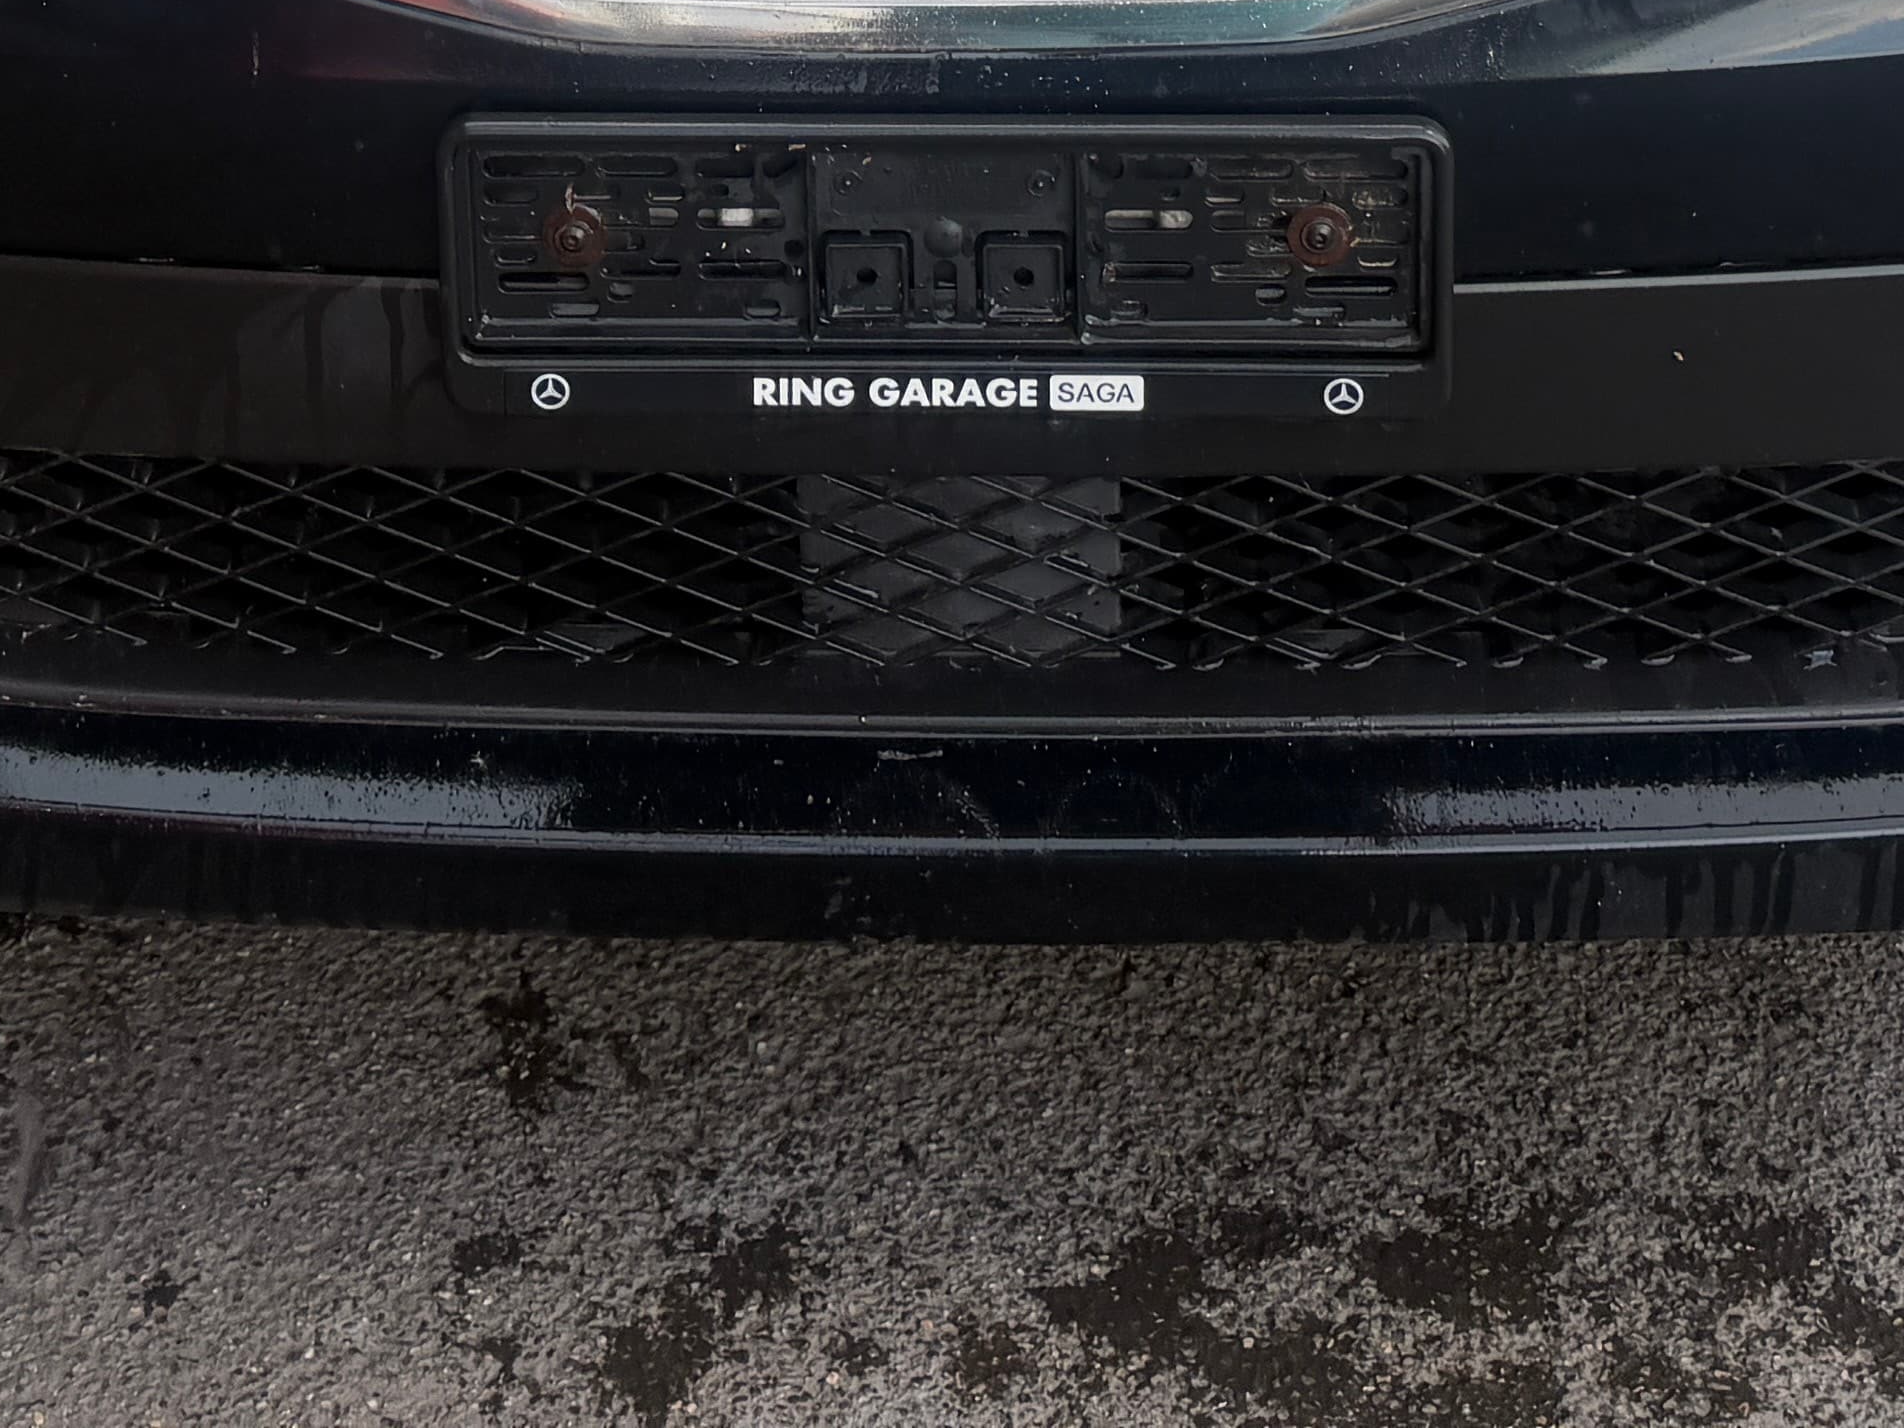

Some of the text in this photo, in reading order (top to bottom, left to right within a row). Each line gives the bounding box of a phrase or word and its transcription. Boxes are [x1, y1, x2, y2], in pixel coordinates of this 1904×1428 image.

[752, 377, 1135, 408] RING GARAGE SAGA
